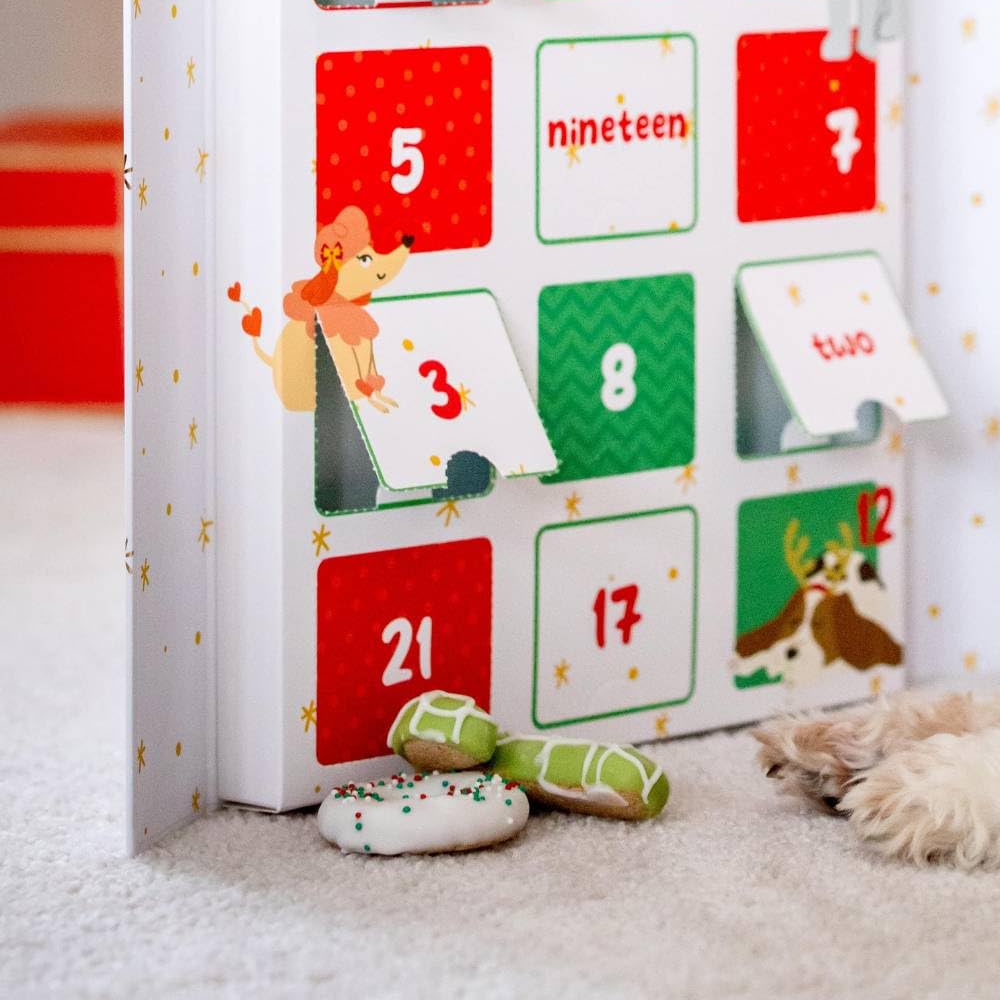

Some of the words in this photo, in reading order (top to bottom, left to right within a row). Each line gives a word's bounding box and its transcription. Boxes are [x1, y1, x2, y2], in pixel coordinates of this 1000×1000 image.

[391, 128, 424, 194] 5
[548, 110, 688, 148] nineteen
[827, 108, 861, 173] 7
[601, 343, 637, 411] 8
[812, 331, 876, 360] two
[418, 360, 463, 420] 3
[857, 487, 895, 546] 12
[592, 584, 642, 649] 17
[381, 616, 432, 686] 21
